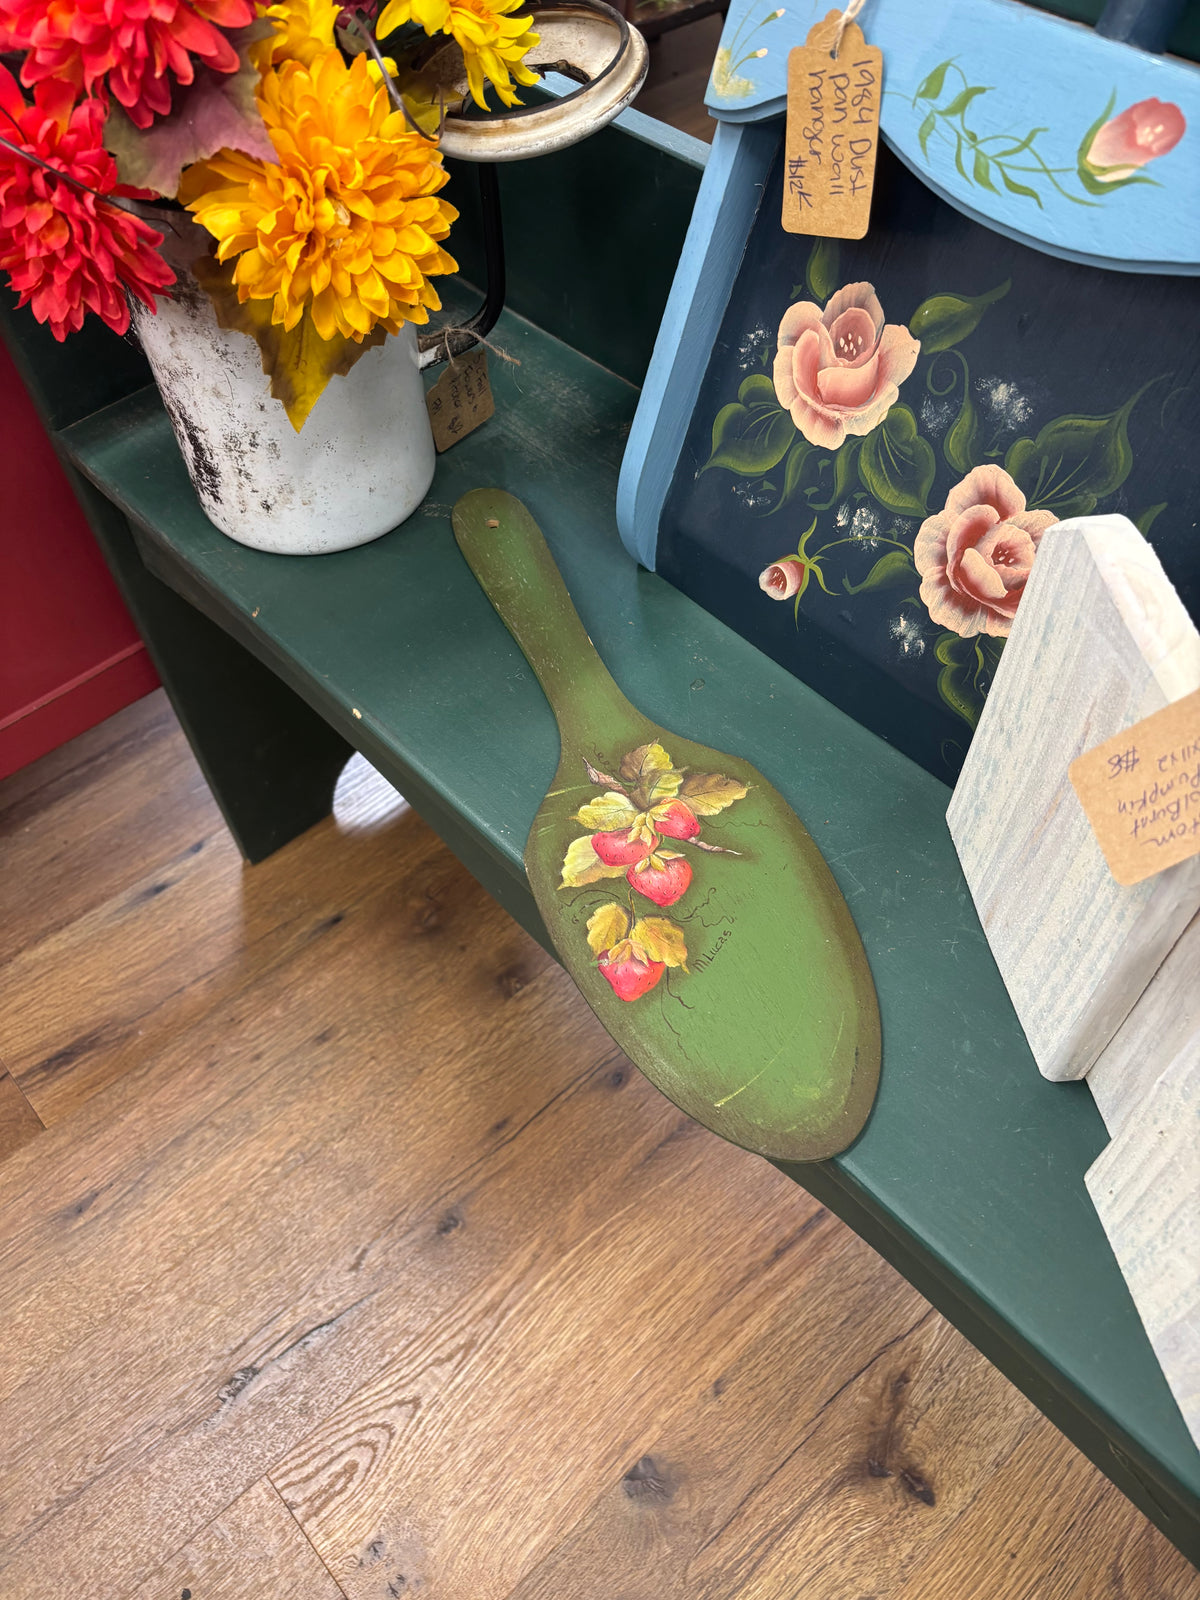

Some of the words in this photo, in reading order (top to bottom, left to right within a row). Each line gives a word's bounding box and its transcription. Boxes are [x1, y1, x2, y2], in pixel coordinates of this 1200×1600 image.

[803, 69, 827, 165] hanger
[829, 73, 850, 123] pan
[851, 60, 876, 125] 1984
[829, 134, 844, 195] wall
[849, 138, 873, 196] Dust
[1157, 738, 1200, 773] x11x2
[1118, 763, 1200, 815] Pumpkin
[1140, 815, 1200, 846] tom
